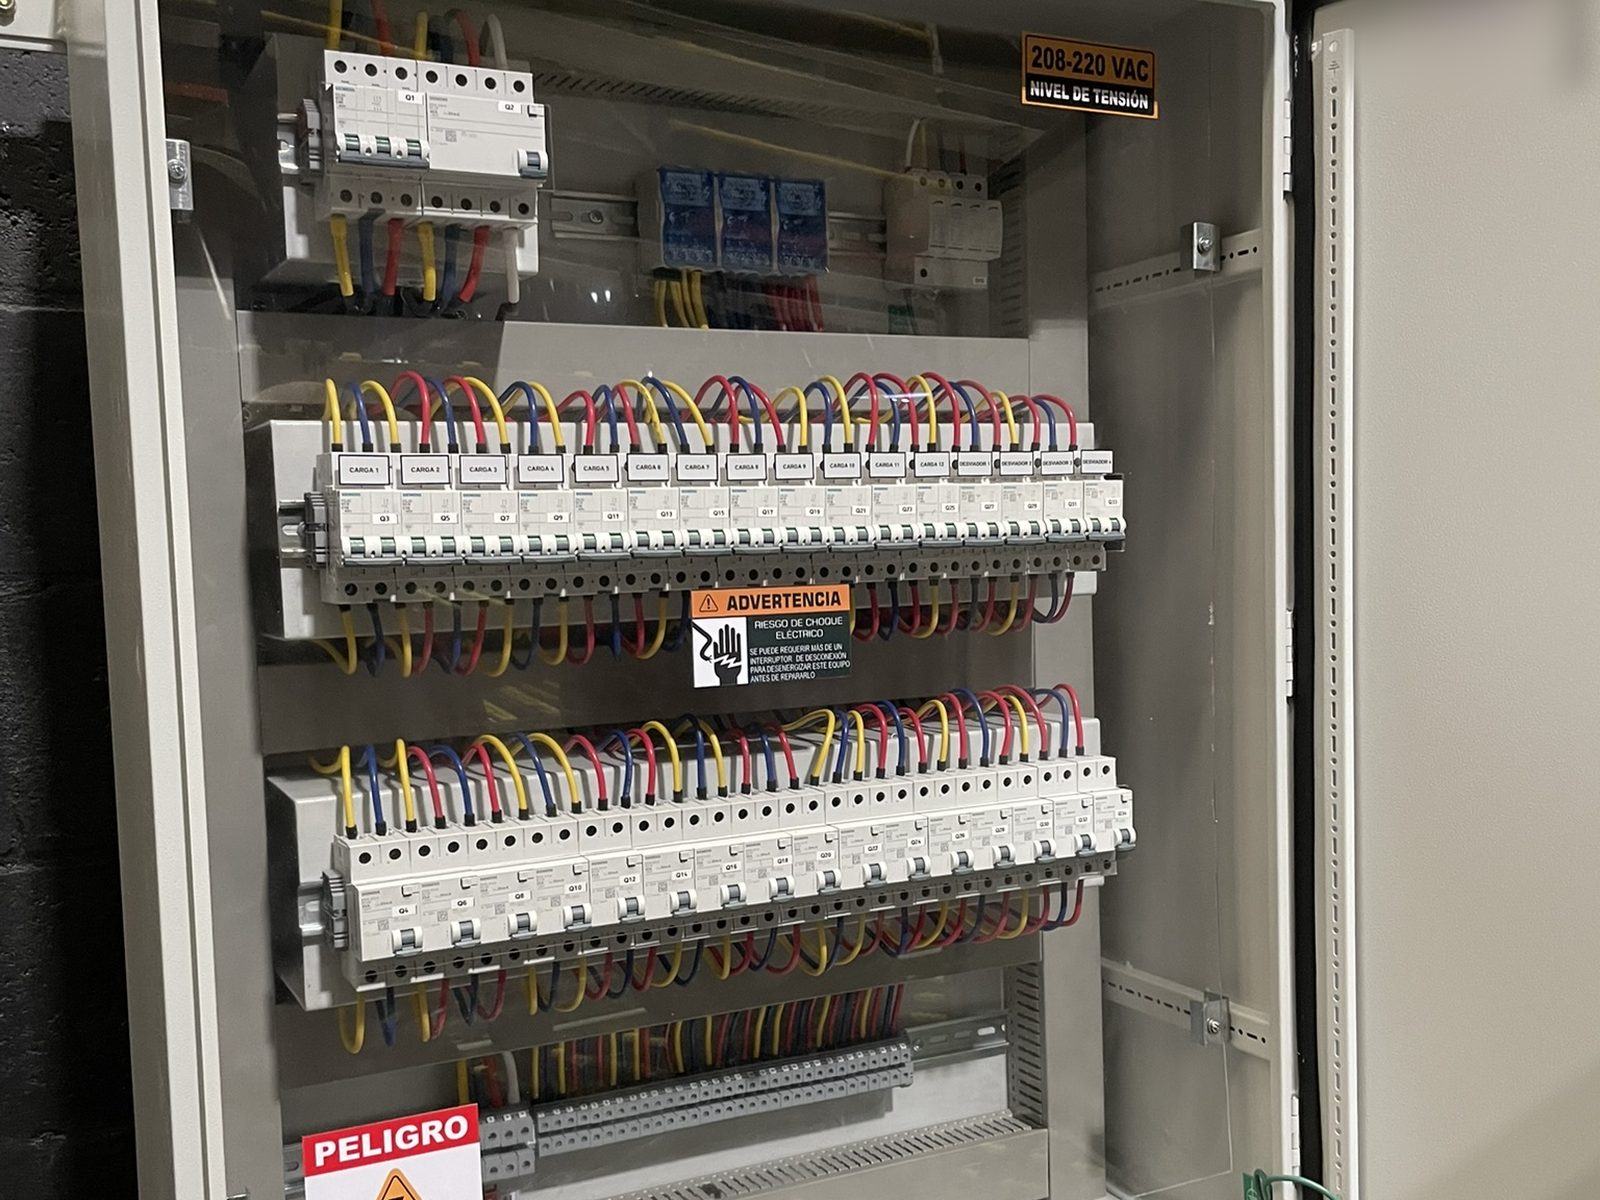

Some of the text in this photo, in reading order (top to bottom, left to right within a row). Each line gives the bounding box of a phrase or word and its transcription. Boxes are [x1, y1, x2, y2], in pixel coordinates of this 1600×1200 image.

[1032, 45, 1149, 82] 208-220 VAC
[1030, 80, 1148, 110] NIVEL DE TENSIÓN
[727, 591, 841, 611] ADVERTENCIA
[754, 616, 843, 629] RIESGO DE CHOQUE
[776, 628, 824, 640] ELÉCTRICO
[759, 646, 778, 655] PUEDE
[780, 645, 810, 653] REQUERIR
[811, 643, 824, 652] MÁS
[750, 655, 793, 665] INTERRUPTOR
[805, 652, 847, 661] DESCONEXIÓN
[767, 662, 811, 673] DESENERGIZAR
[813, 662, 827, 670] ESTE
[828, 660, 850, 669] EQUIPO
[750, 671, 816, 682] ANTES DE REPARARLO
[314, 1114, 468, 1168] PELIGRO
